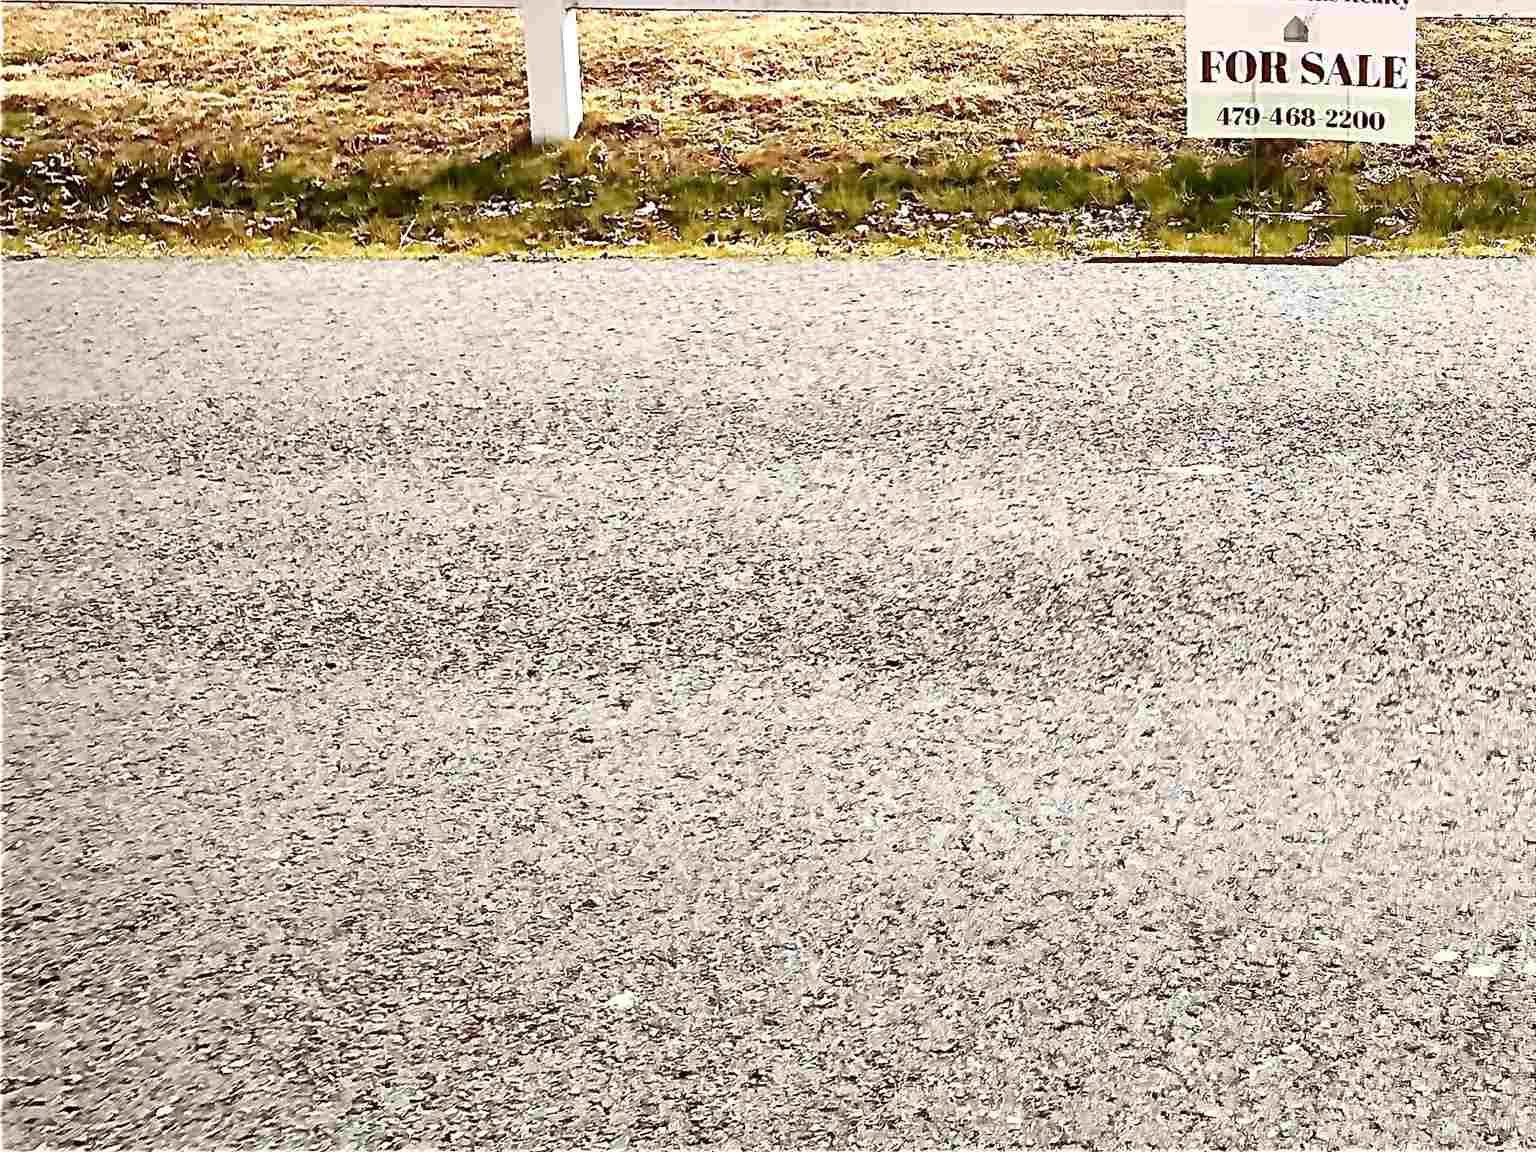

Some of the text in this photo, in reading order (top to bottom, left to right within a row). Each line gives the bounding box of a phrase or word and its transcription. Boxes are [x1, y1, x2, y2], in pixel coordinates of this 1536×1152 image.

[1200, 50, 1409, 89] FOR SALE
[1216, 107, 1385, 132] 479-468-2200
